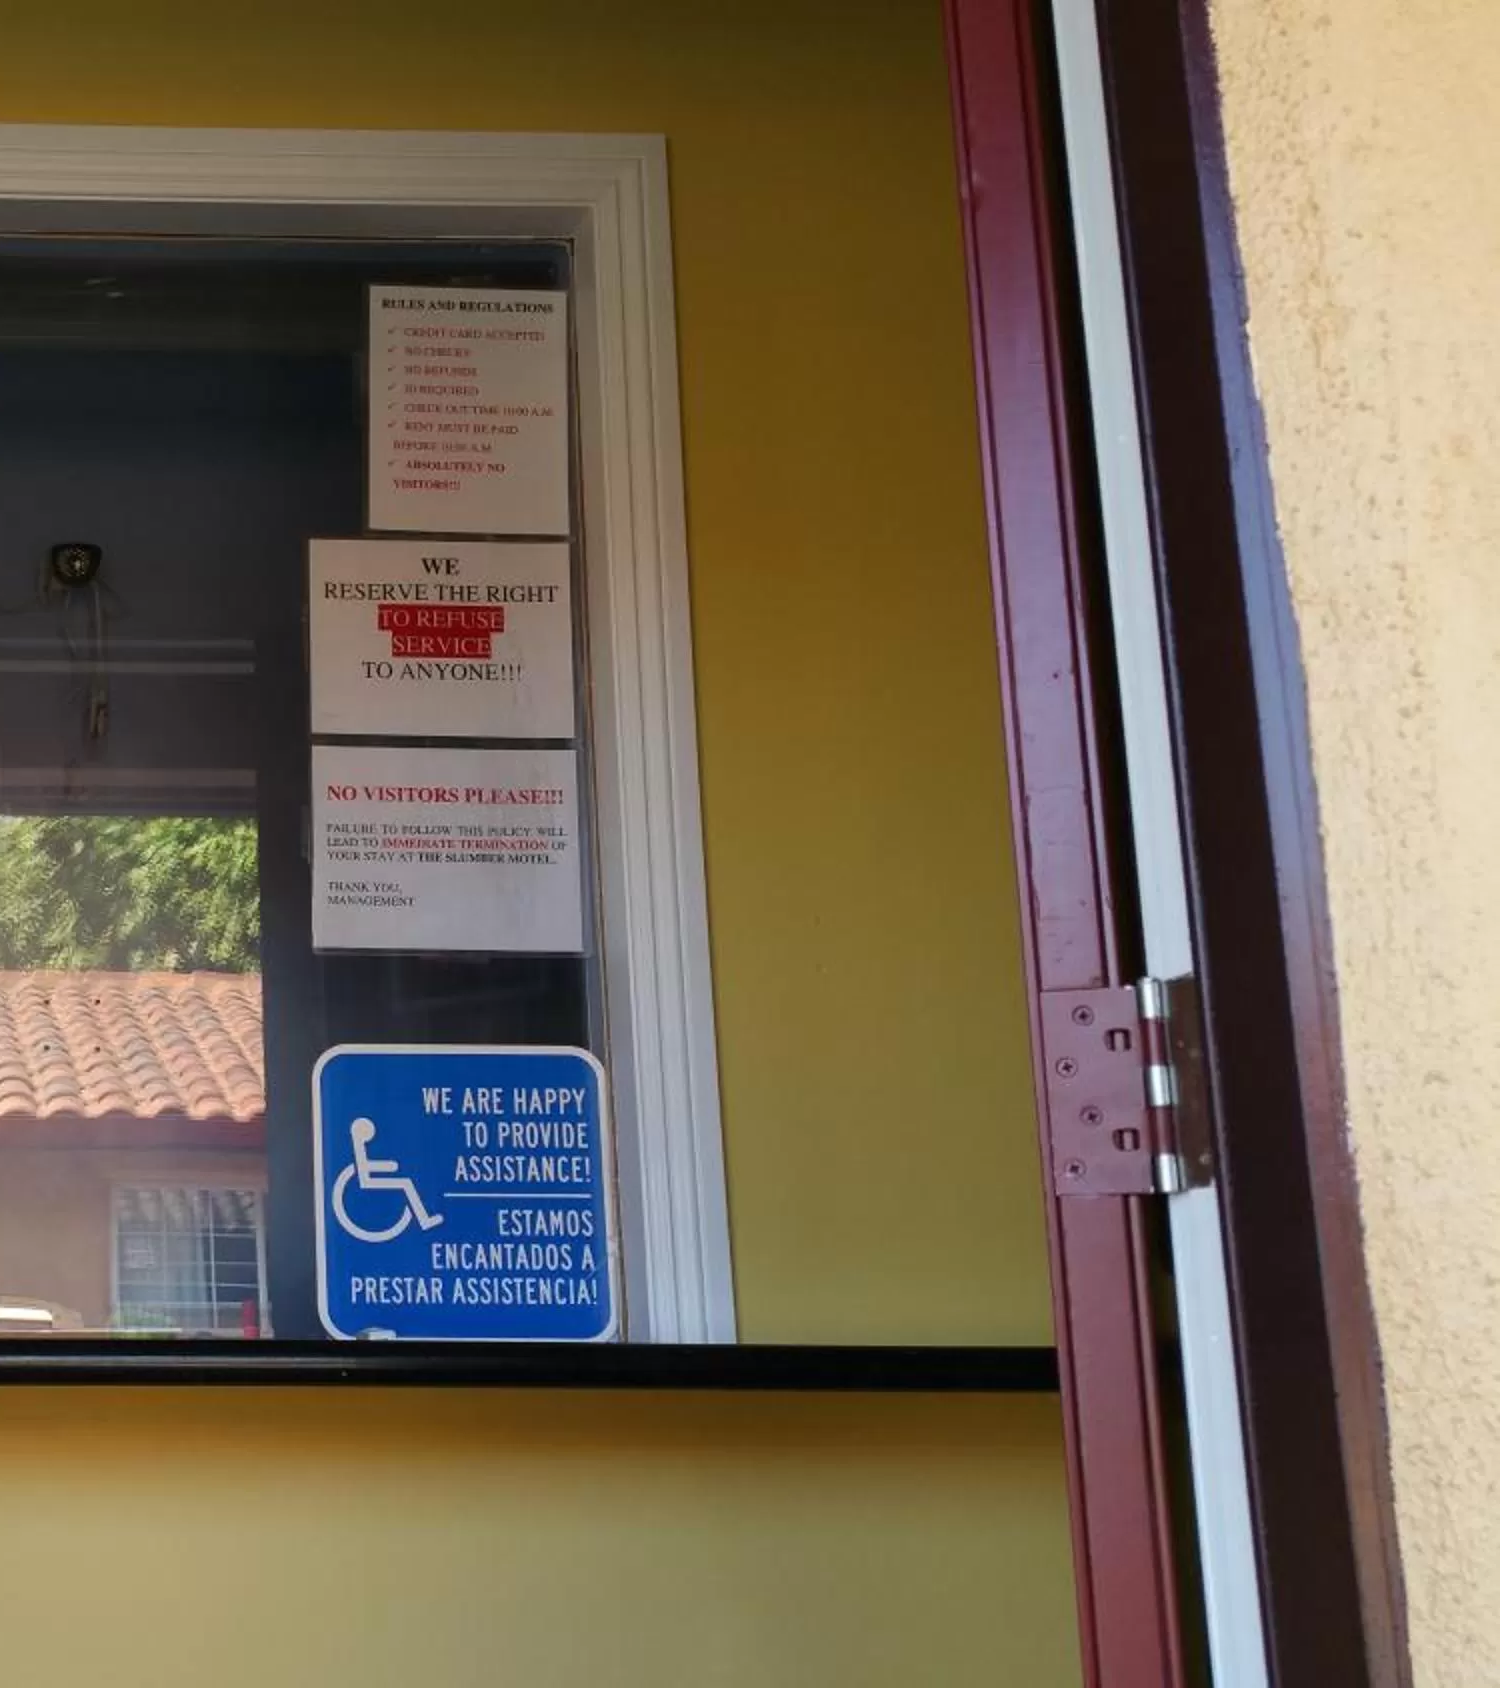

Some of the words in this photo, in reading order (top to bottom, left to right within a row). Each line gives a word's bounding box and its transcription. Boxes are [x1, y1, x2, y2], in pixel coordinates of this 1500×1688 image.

[381, 298, 424, 310] RULES
[426, 300, 455, 311] AND
[460, 301, 555, 314] REGULATIONS
[449, 328, 482, 339] CARD
[471, 405, 499, 416] TIME
[405, 459, 483, 473] ABSOLUTELY
[487, 462, 506, 473] NO
[421, 557, 460, 576] WE
[324, 582, 428, 601] RESERVE
[434, 584, 481, 602] THE
[485, 585, 560, 604] RIGHT
[380, 609, 410, 627] TO
[416, 610, 504, 630] REFUSE
[392, 636, 491, 655] SERVICE
[362, 661, 393, 680] TO
[400, 662, 522, 682] ANYONE!!!
[327, 785, 357, 801] NO
[363, 786, 459, 803] VISITORS
[464, 788, 565, 806] PLEASE!!!
[326, 823, 377, 835] FAILURE
[381, 824, 398, 835] TO
[402, 825, 452, 836] FOLLOW
[458, 826, 483, 837] THIS
[487, 826, 532, 838] POLICY
[536, 827, 568, 838] WILL
[326, 837, 360, 848] LEAD
[362, 838, 379, 848] TO
[381, 838, 457, 850] IMMEDIATE
[460, 839, 549, 851] TERMINATION
[551, 841, 567, 852] OF
[326, 851, 361, 862] YOUR
[363, 852, 395, 863] STAY
[399, 853, 417, 863] AT
[419, 853, 443, 864] THE
[445, 853, 505, 864] SLUMBER
[328, 881, 370, 893] THANK
[327, 895, 416, 907] MANAGEMENT
[422, 1087, 452, 1114] WE
[462, 1087, 504, 1115] ARE
[513, 1087, 586, 1115] HAPPY
[463, 1121, 488, 1149] TO
[498, 1121, 589, 1149] PROVIDE
[454, 1155, 592, 1183] ASSISTANCE!
[498, 1209, 594, 1237] ESTAMOS
[431, 1243, 573, 1271] ENCANTADOS
[581, 1244, 596, 1271] A
[351, 1276, 444, 1304] PRESTAR
[452, 1277, 599, 1306] ASSISTENCIA!
